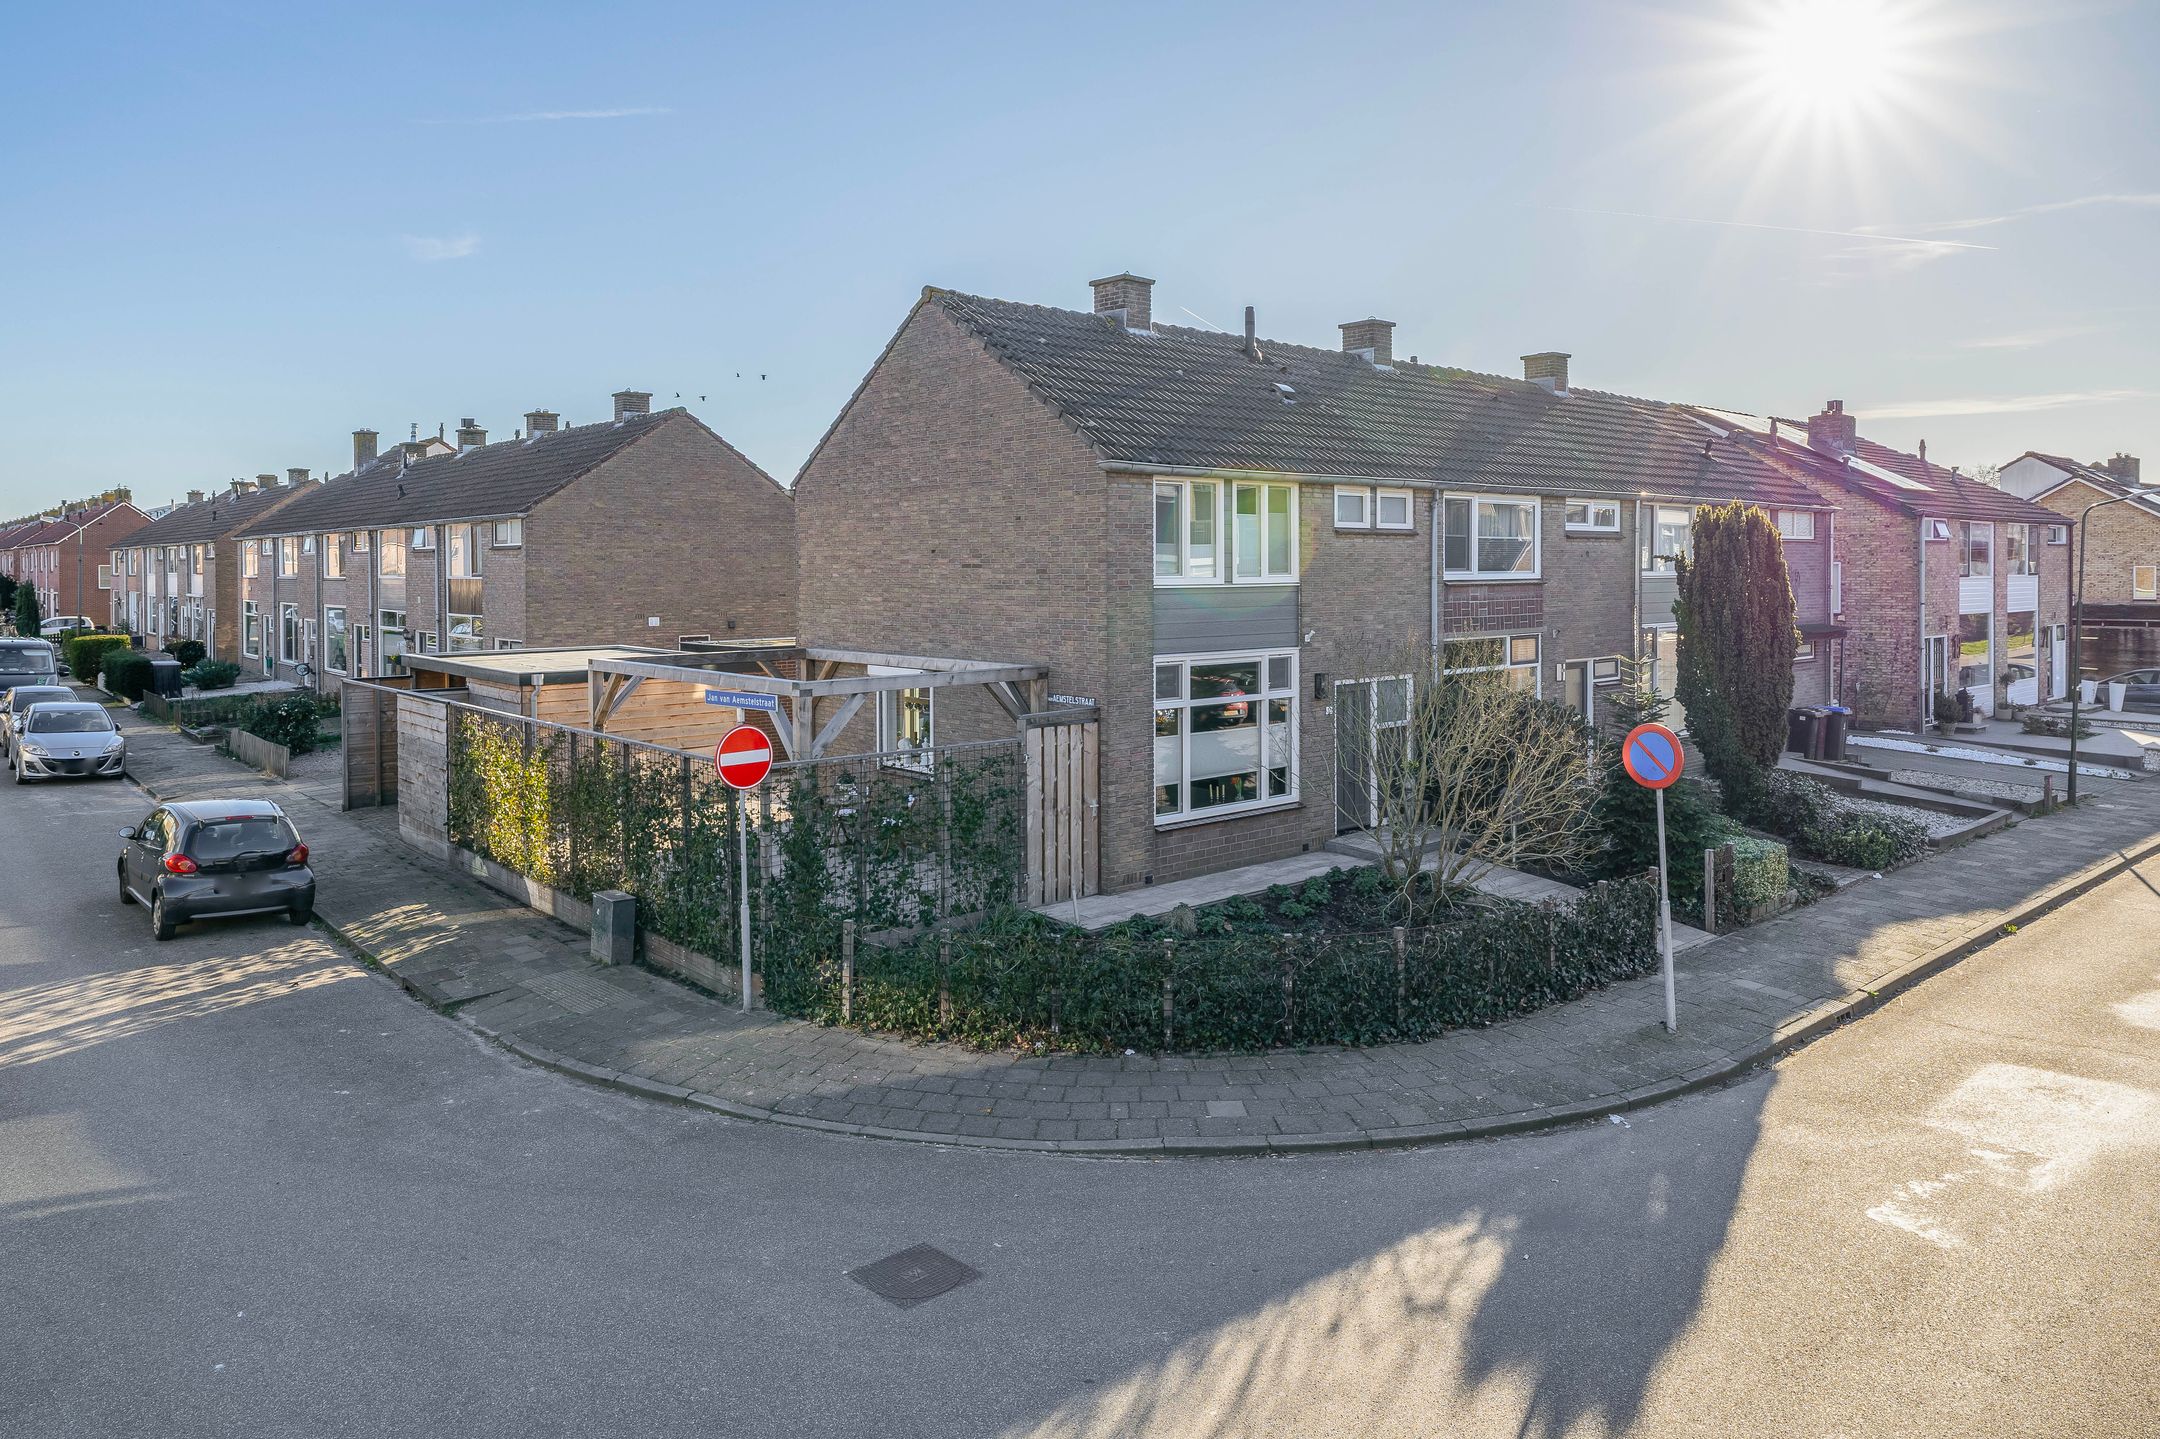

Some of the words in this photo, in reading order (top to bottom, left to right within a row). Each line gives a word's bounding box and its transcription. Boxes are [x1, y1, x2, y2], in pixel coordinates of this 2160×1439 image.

[707, 693, 718, 702] Jan
[719, 695, 730, 703] van
[731, 695, 775, 708] Aemstelstraat
